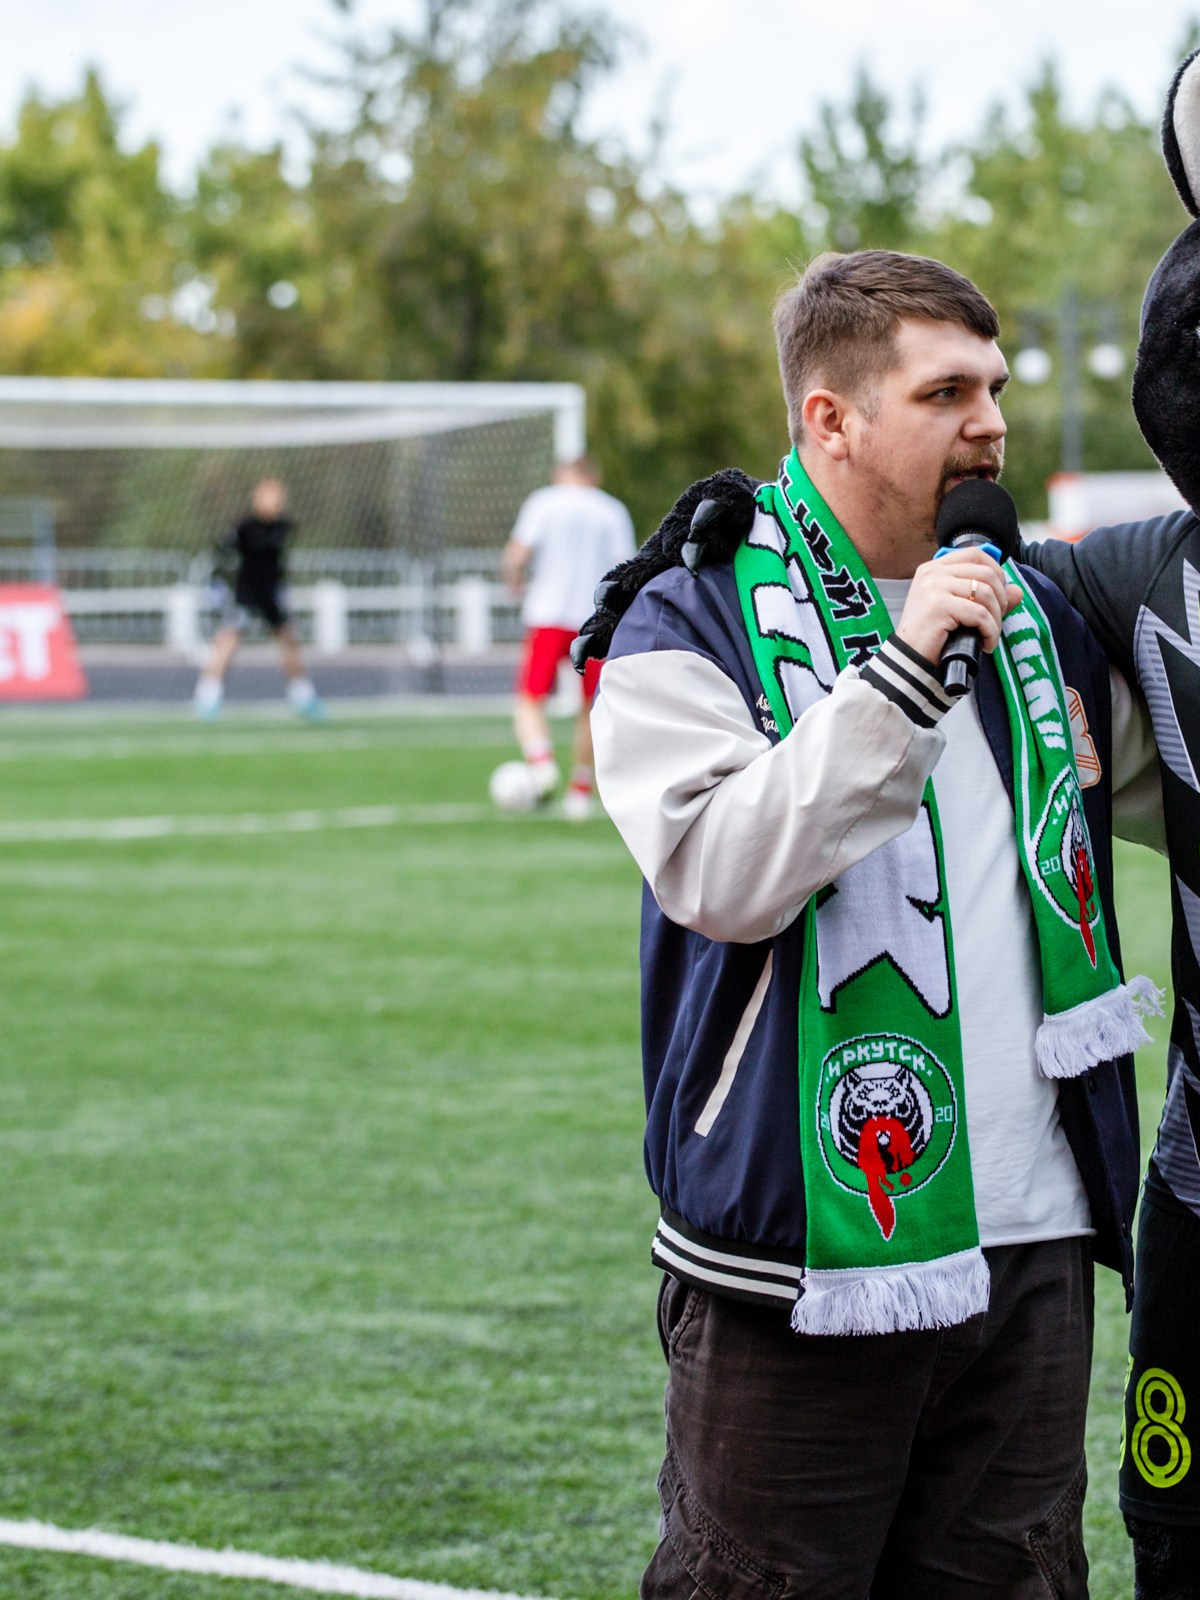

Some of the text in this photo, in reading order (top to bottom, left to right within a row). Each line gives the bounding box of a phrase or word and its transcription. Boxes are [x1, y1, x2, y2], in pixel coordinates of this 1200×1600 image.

[1040, 854, 1061, 876] 20
[827, 1041, 928, 1078] ИРКУТСК
[935, 1105, 953, 1123] 20
[1119, 1352, 1192, 1488] 8
